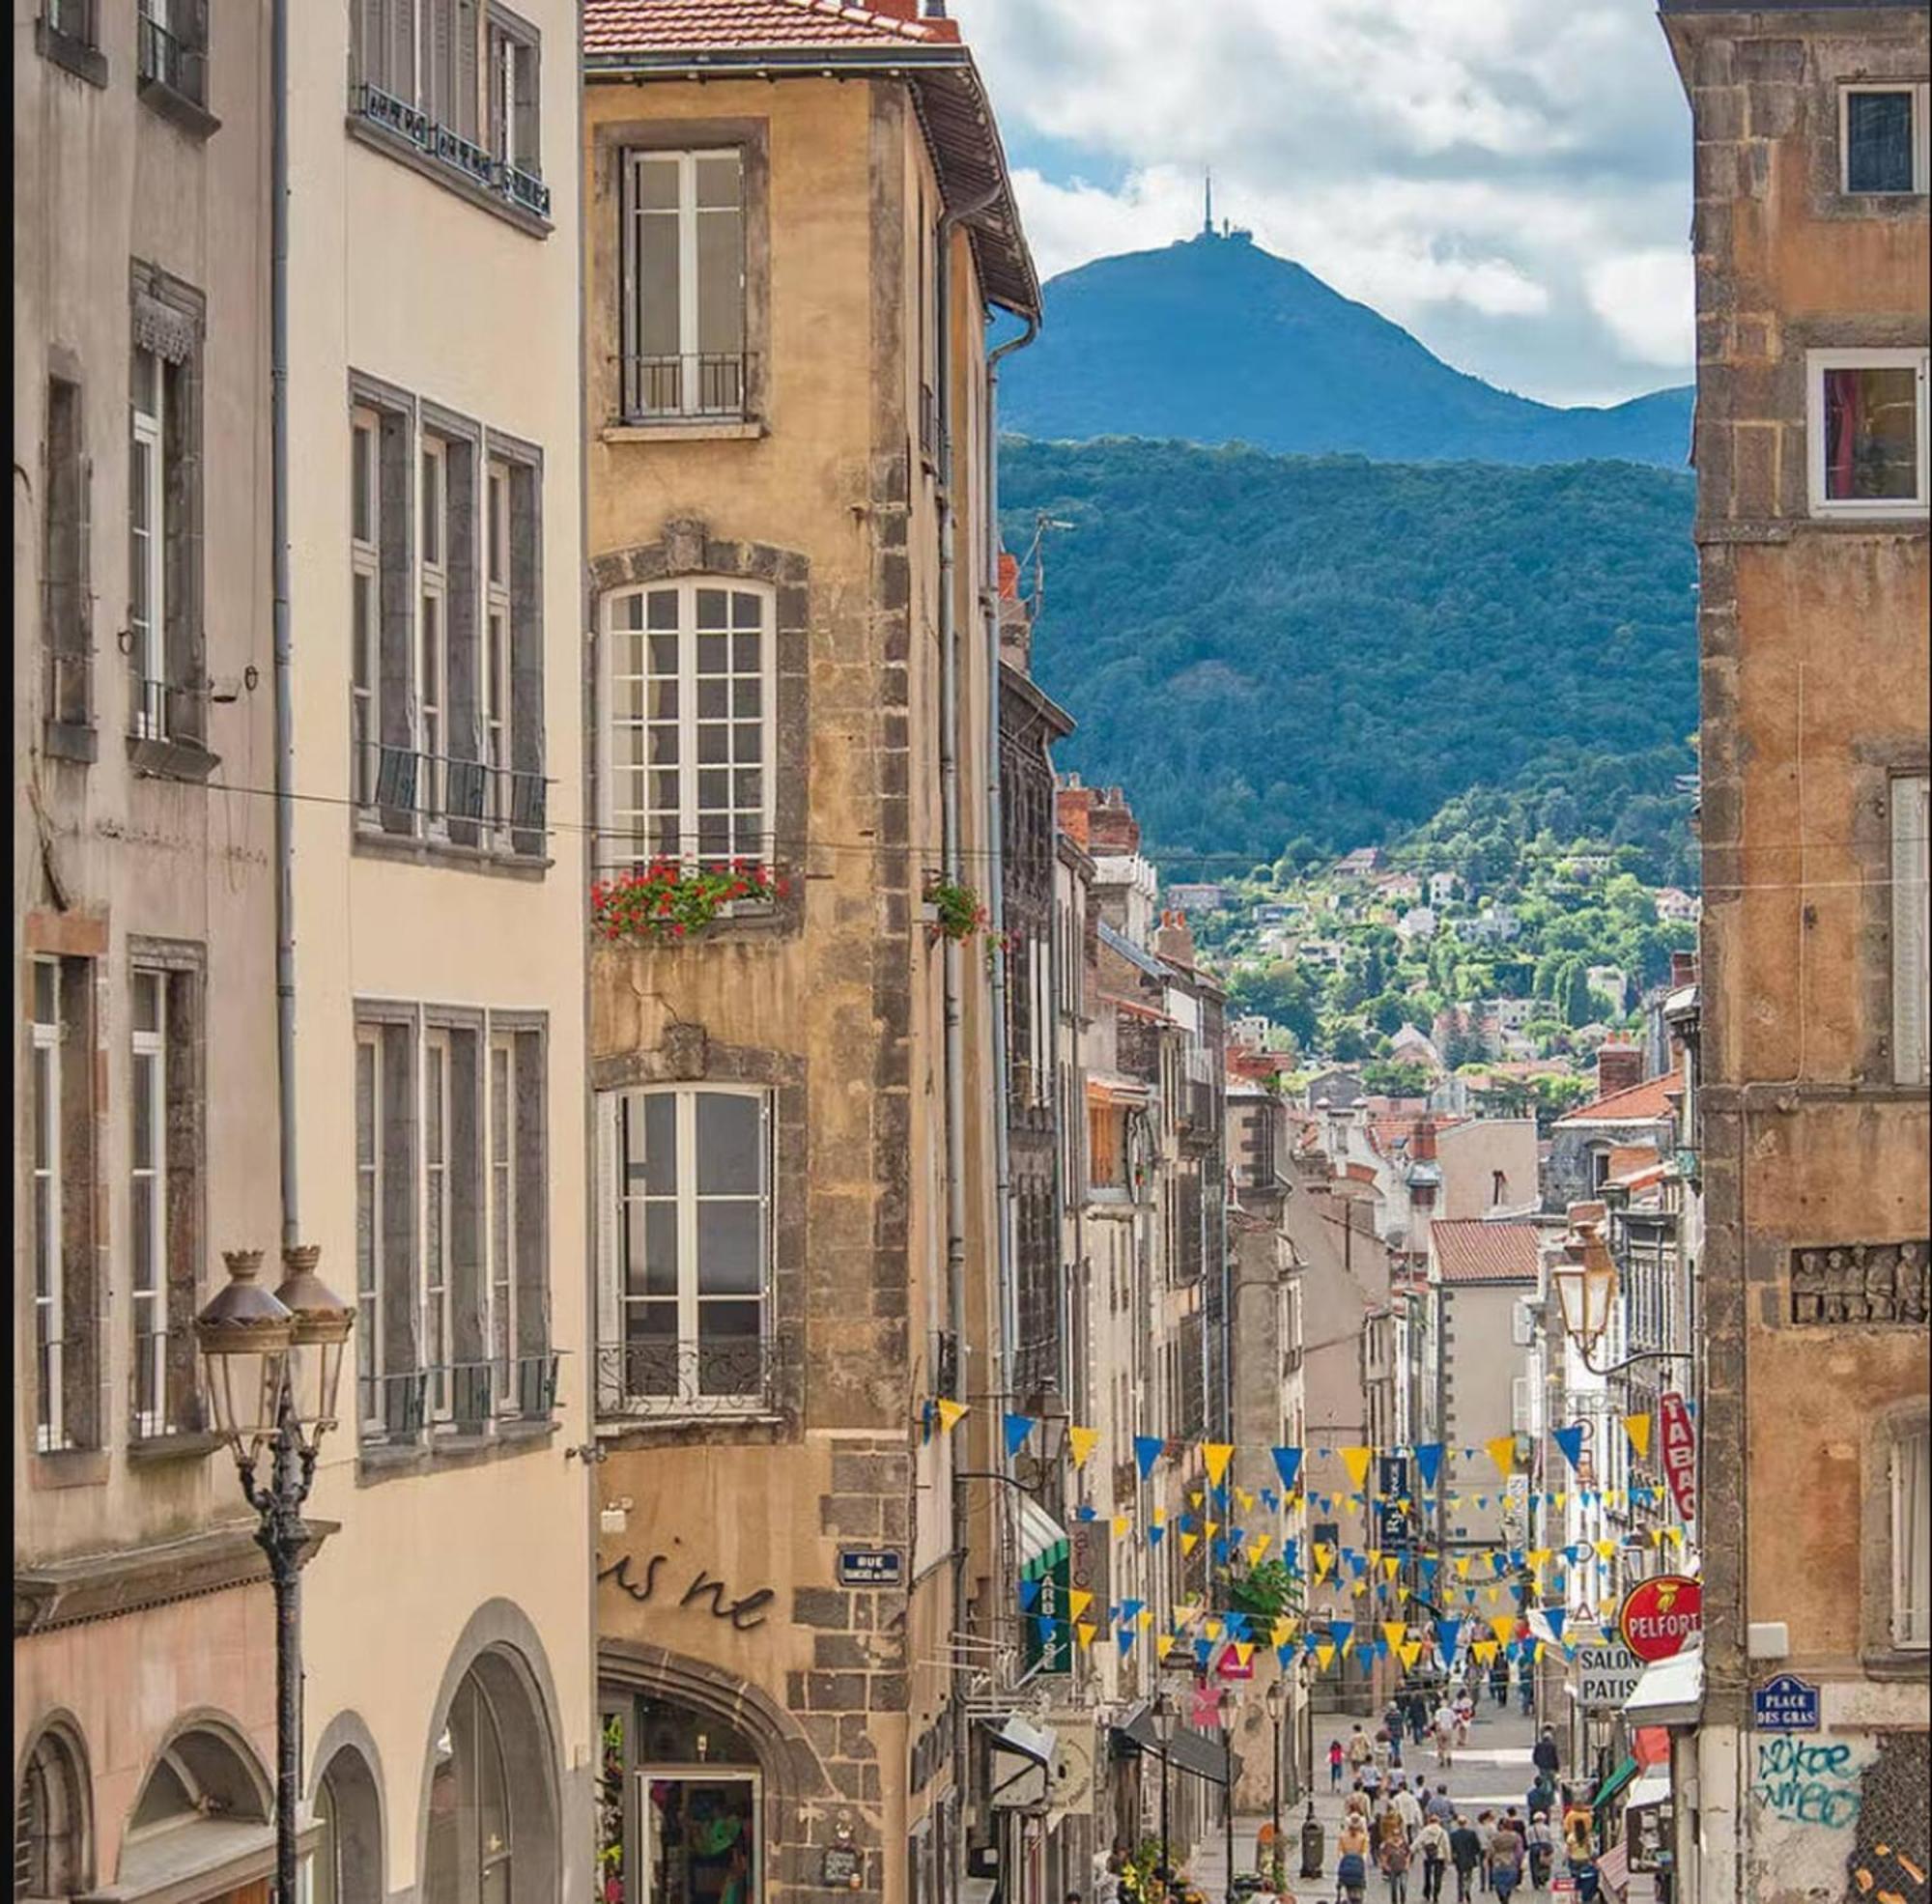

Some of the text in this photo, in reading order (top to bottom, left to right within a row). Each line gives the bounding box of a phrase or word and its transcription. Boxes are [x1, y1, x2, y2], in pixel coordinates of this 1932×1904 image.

[1662, 1397, 1695, 1516] TABAC
[1629, 1612, 1700, 1639] PELFORT
[1580, 1649, 1640, 1670] SALON
[1583, 1679, 1638, 1699] PATIS
[1765, 1694, 1806, 1709] PLACE
[1757, 1711, 1815, 1724] DES GRAS
